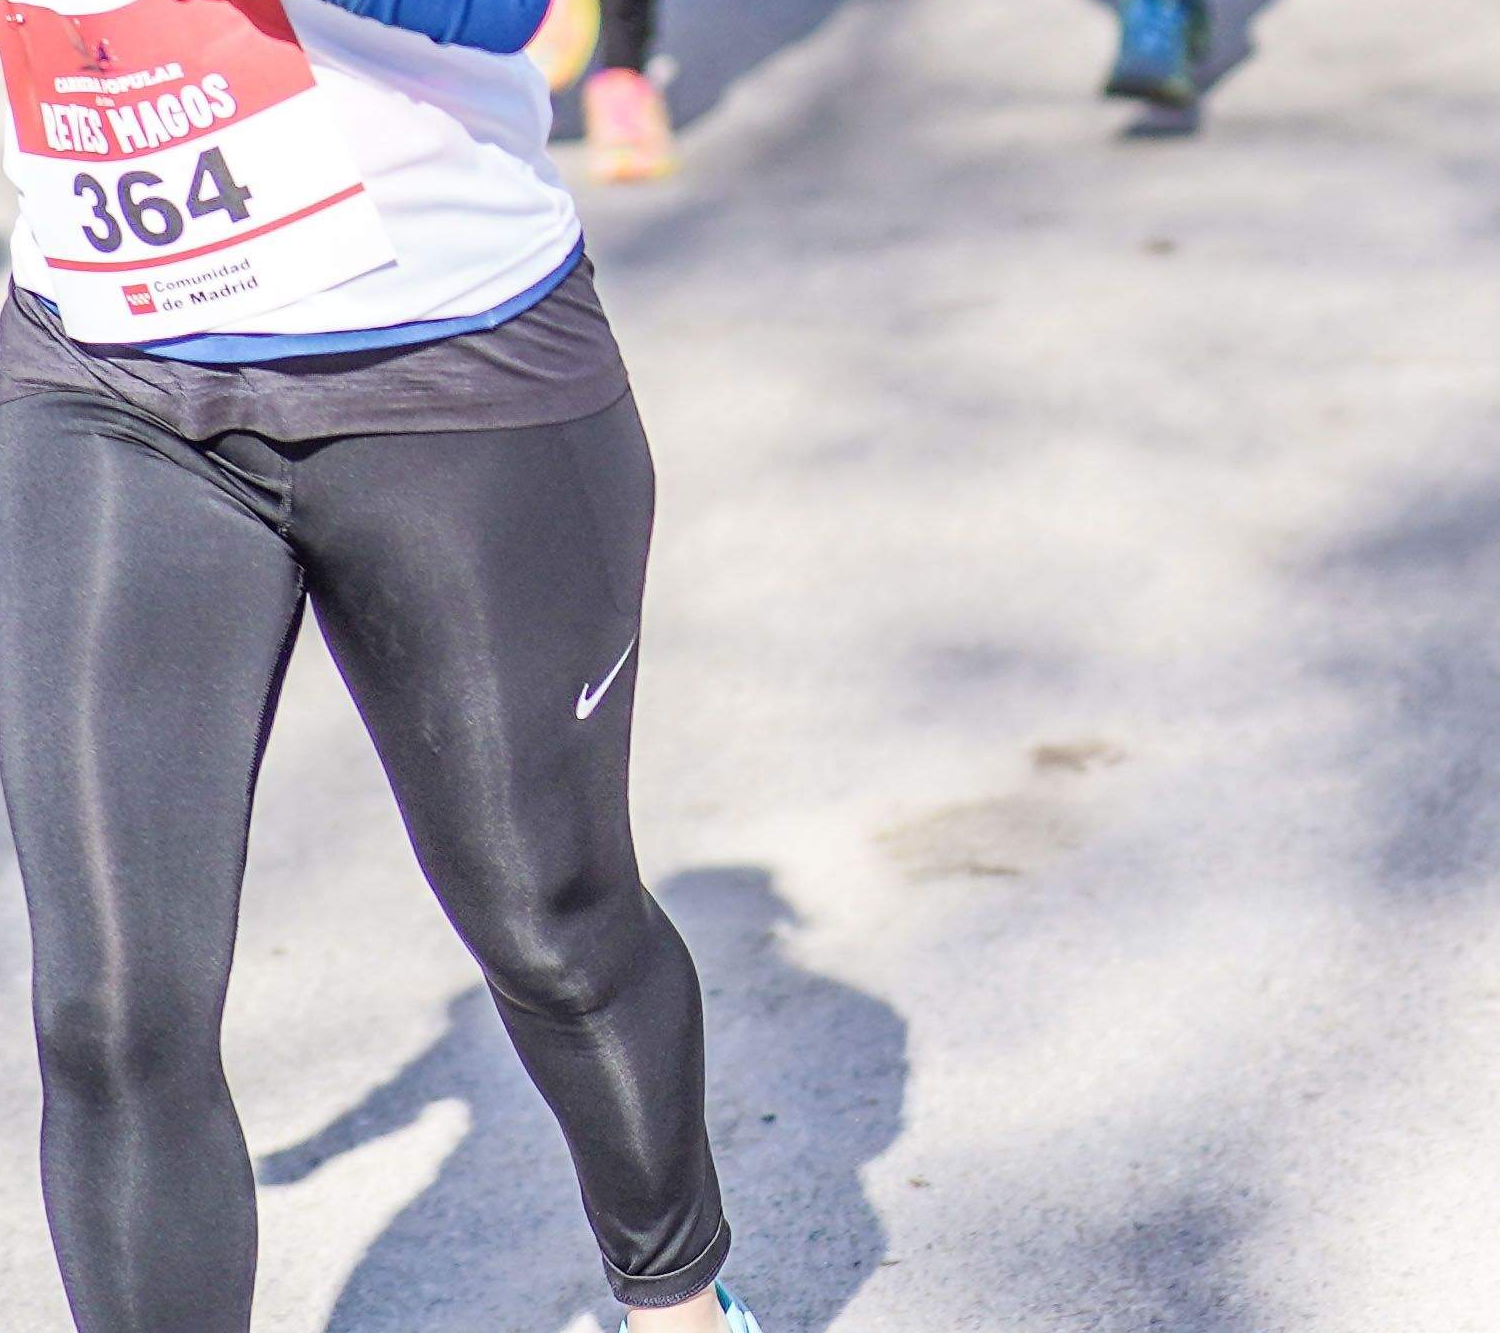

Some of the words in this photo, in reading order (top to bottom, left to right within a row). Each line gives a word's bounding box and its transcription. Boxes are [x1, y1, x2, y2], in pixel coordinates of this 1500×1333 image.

[106, 73, 236, 154] MAGOS
[74, 146, 252, 253] 364
[153, 258, 251, 293] Comunidad
[162, 299, 184, 312] de
[190, 275, 259, 305] Madrid
